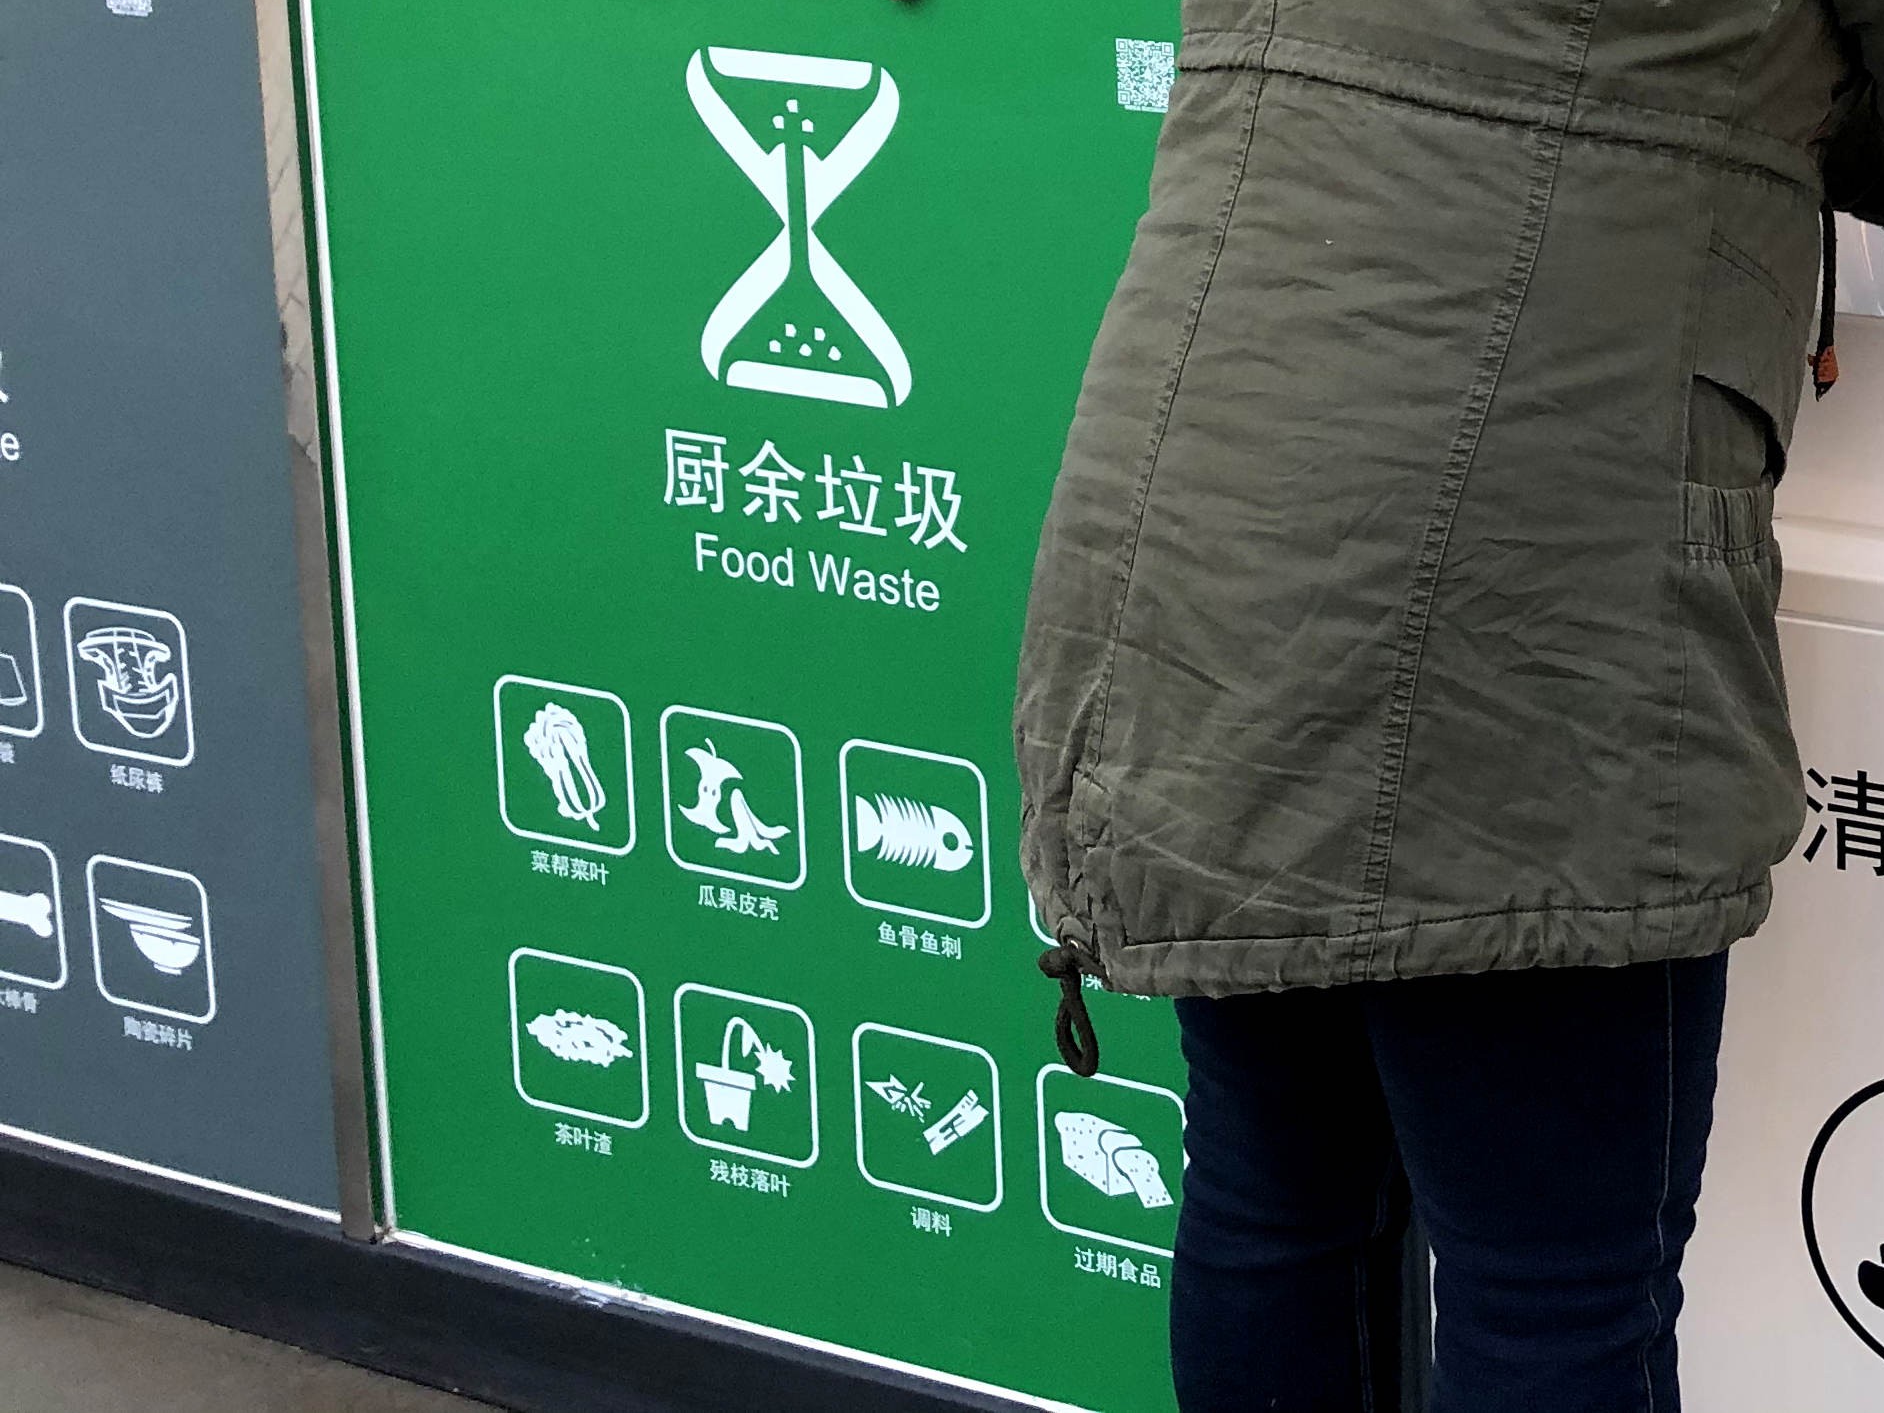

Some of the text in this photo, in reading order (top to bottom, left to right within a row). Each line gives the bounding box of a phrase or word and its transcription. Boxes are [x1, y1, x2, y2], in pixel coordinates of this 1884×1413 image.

[663, 428, 968, 553] 厨余垃圾
[694, 531, 941, 612] Food Waste
[530, 849, 610, 886] 菜帮菜叶
[697, 884, 780, 922] 瓜果皮壳
[877, 919, 963, 960] 鱼骨鱼刺
[553, 1121, 613, 1157] 茶叶渣
[709, 1157, 792, 1198] 残枝落叶
[910, 1205, 953, 1238] 调料
[1073, 1245, 1162, 1288] 过期食品
